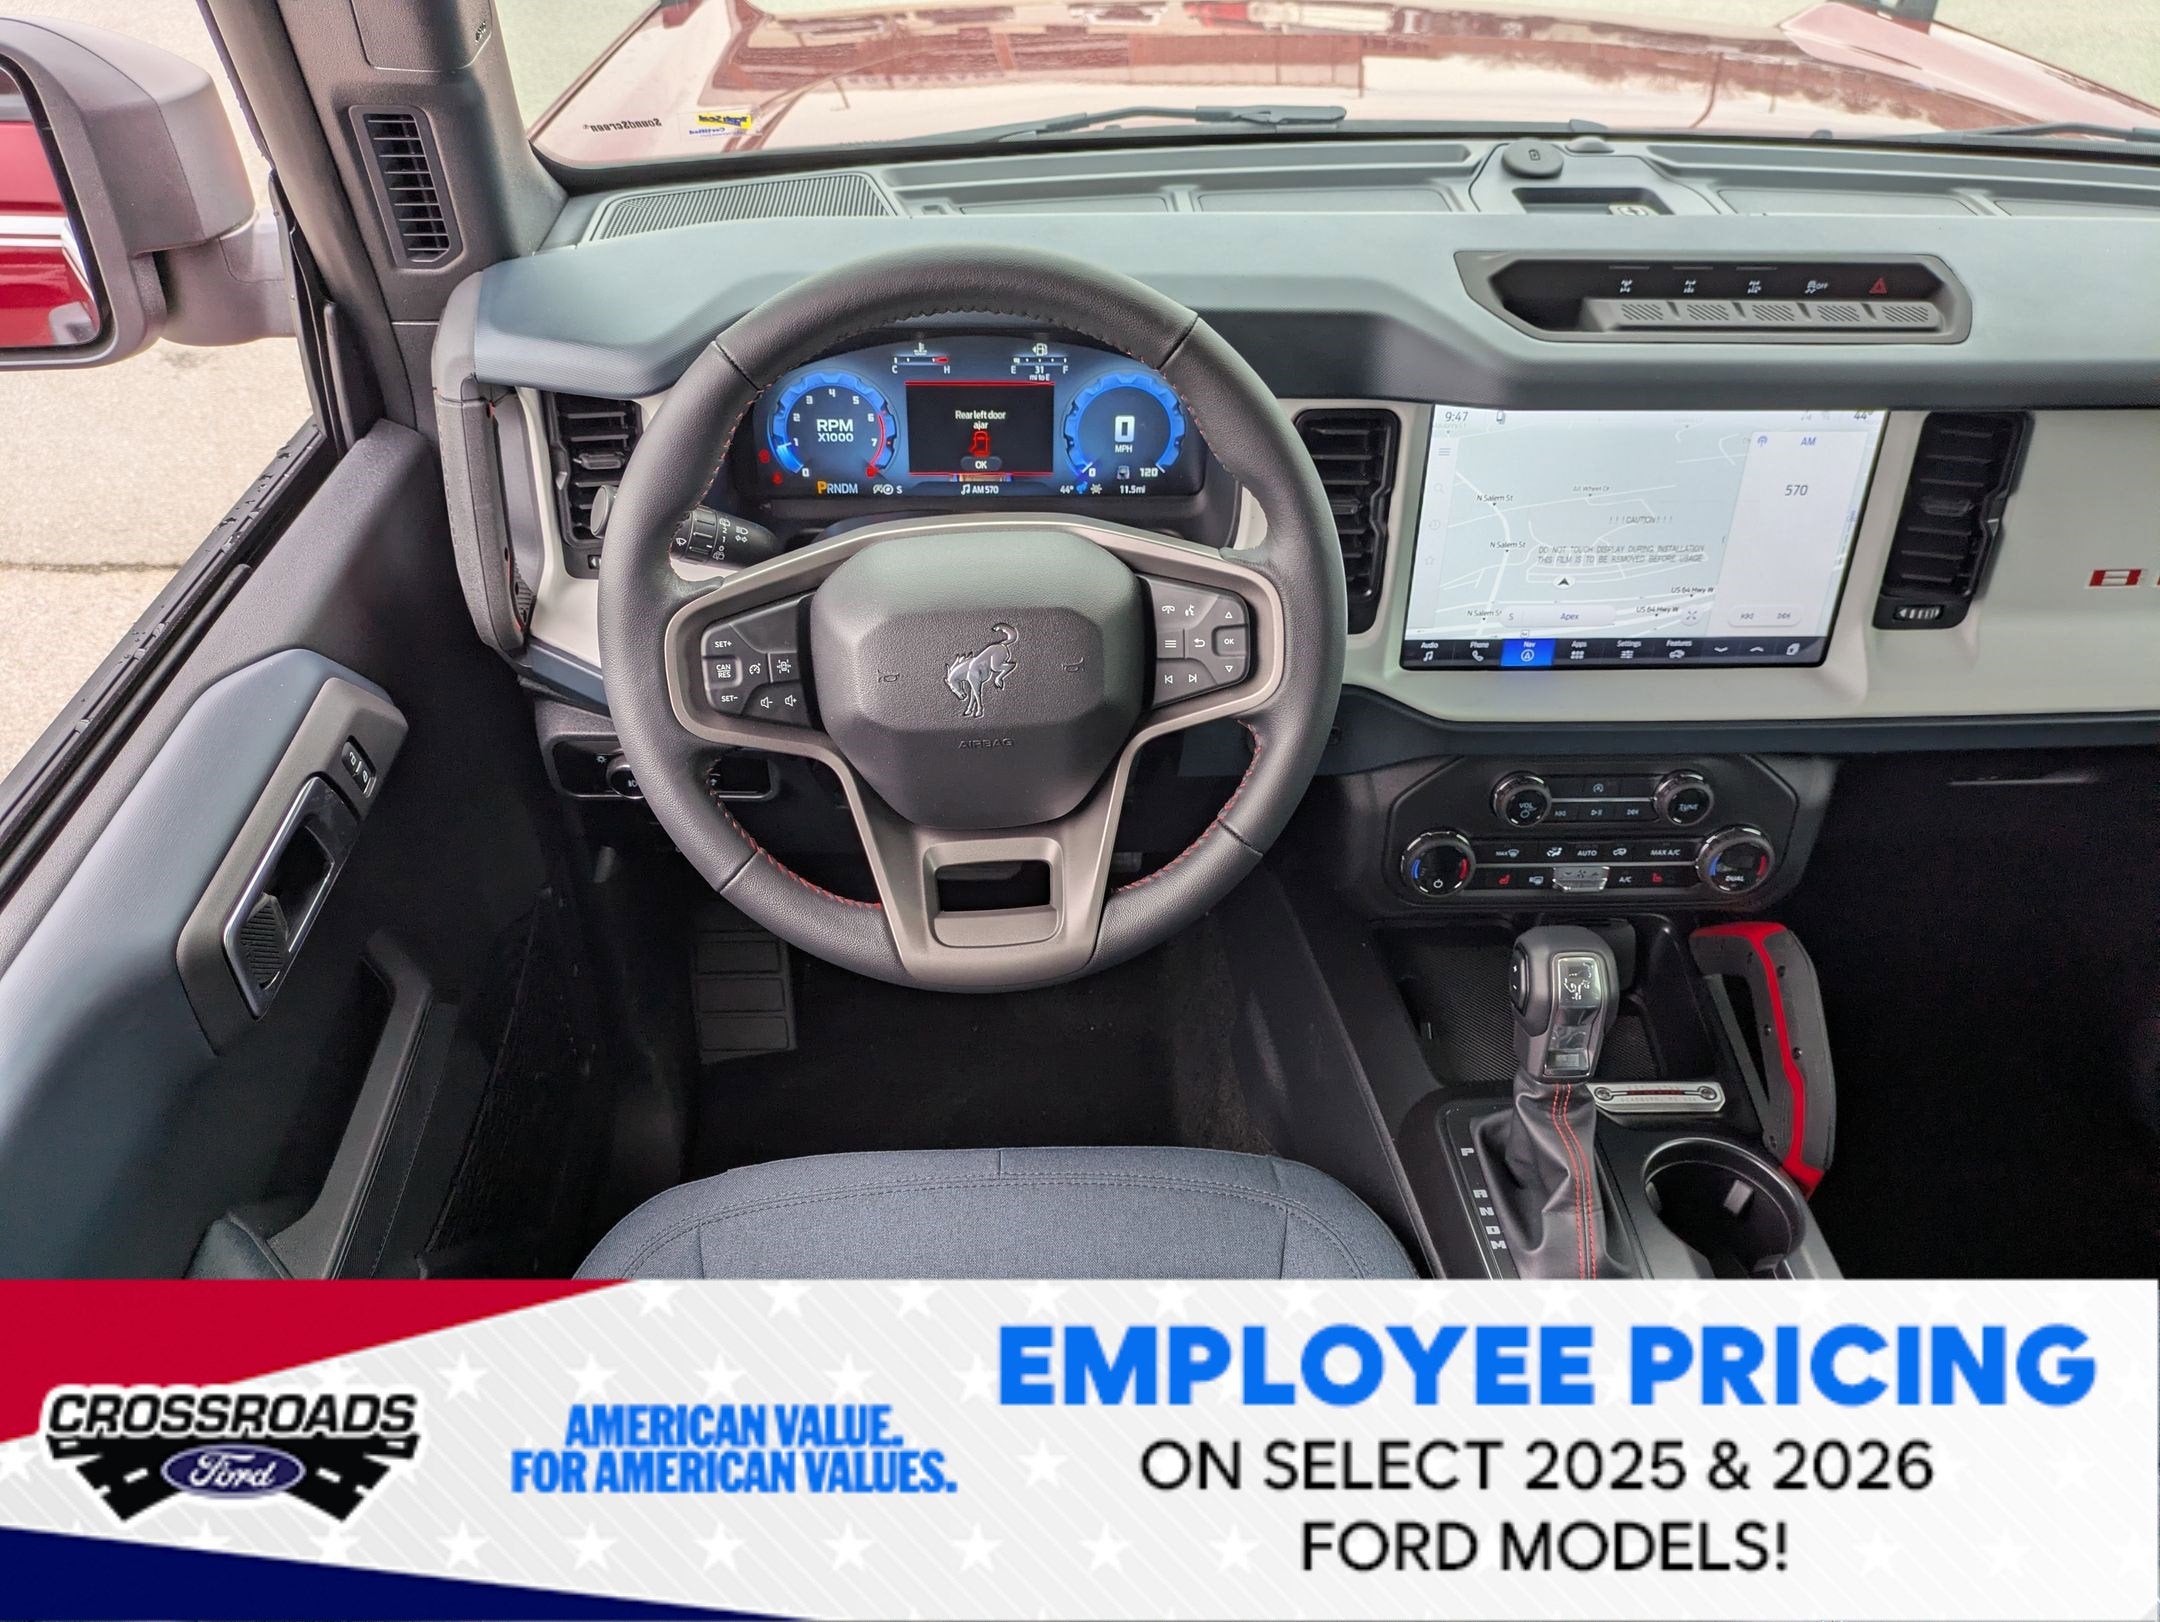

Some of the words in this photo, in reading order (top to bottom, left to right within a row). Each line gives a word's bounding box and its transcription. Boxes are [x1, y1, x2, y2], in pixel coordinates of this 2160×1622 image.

[891, 365, 898, 374] C
[943, 365, 951, 374] H
[1010, 365, 1017, 375] E
[1034, 365, 1044, 374] 31
[1062, 365, 1069, 375] F
[828, 388, 836, 398] 4
[806, 395, 813, 405] 3
[852, 395, 860, 405] 5
[793, 413, 800, 422] 2
[867, 413, 874, 422] 6
[955, 409, 973, 420] Rear
[973, 409, 987, 420] left
[987, 409, 1006, 420] door
[1445, 411, 1468, 422] 9:47
[816, 418, 854, 432] RPM
[973, 421, 988, 430] ajar
[1114, 415, 1136, 443] 0
[793, 437, 799, 446] 1
[818, 432, 854, 442] X1000
[1800, 437, 1816, 446] AM
[871, 438, 878, 447] 7
[1114, 445, 1133, 453] MPH
[974, 460, 988, 469] OK
[801, 467, 810, 478] 0
[1088, 467, 1096, 477] 0
[1139, 467, 1159, 477] 120
[896, 486, 903, 494] S
[971, 485, 985, 494] AM
[985, 485, 999, 494] 570
[1784, 485, 1808, 496] 570
[1476, 494, 1483, 502] N
[1483, 494, 1504, 502] Salem
[1505, 494, 1513, 502] St
[1560, 612, 1579, 621] Apex
[715, 640, 733, 648] SET+
[1420, 641, 1438, 649] Audio
[1470, 641, 1489, 649] Phone
[1572, 641, 1587, 649] Apps
[1616, 639, 1642, 649] Settings
[1666, 639, 1693, 647] Features
[716, 663, 731, 671] CAN
[958, 738, 1015, 749] AIRBAG
[1679, 803, 1698, 811] TUNE
[1619, 875, 1632, 883] A/C
[1460, 1147, 1475, 1157] P
[1479, 1206, 1495, 1216] N
[1485, 1225, 1501, 1235] D
[1490, 1240, 1507, 1250] M
